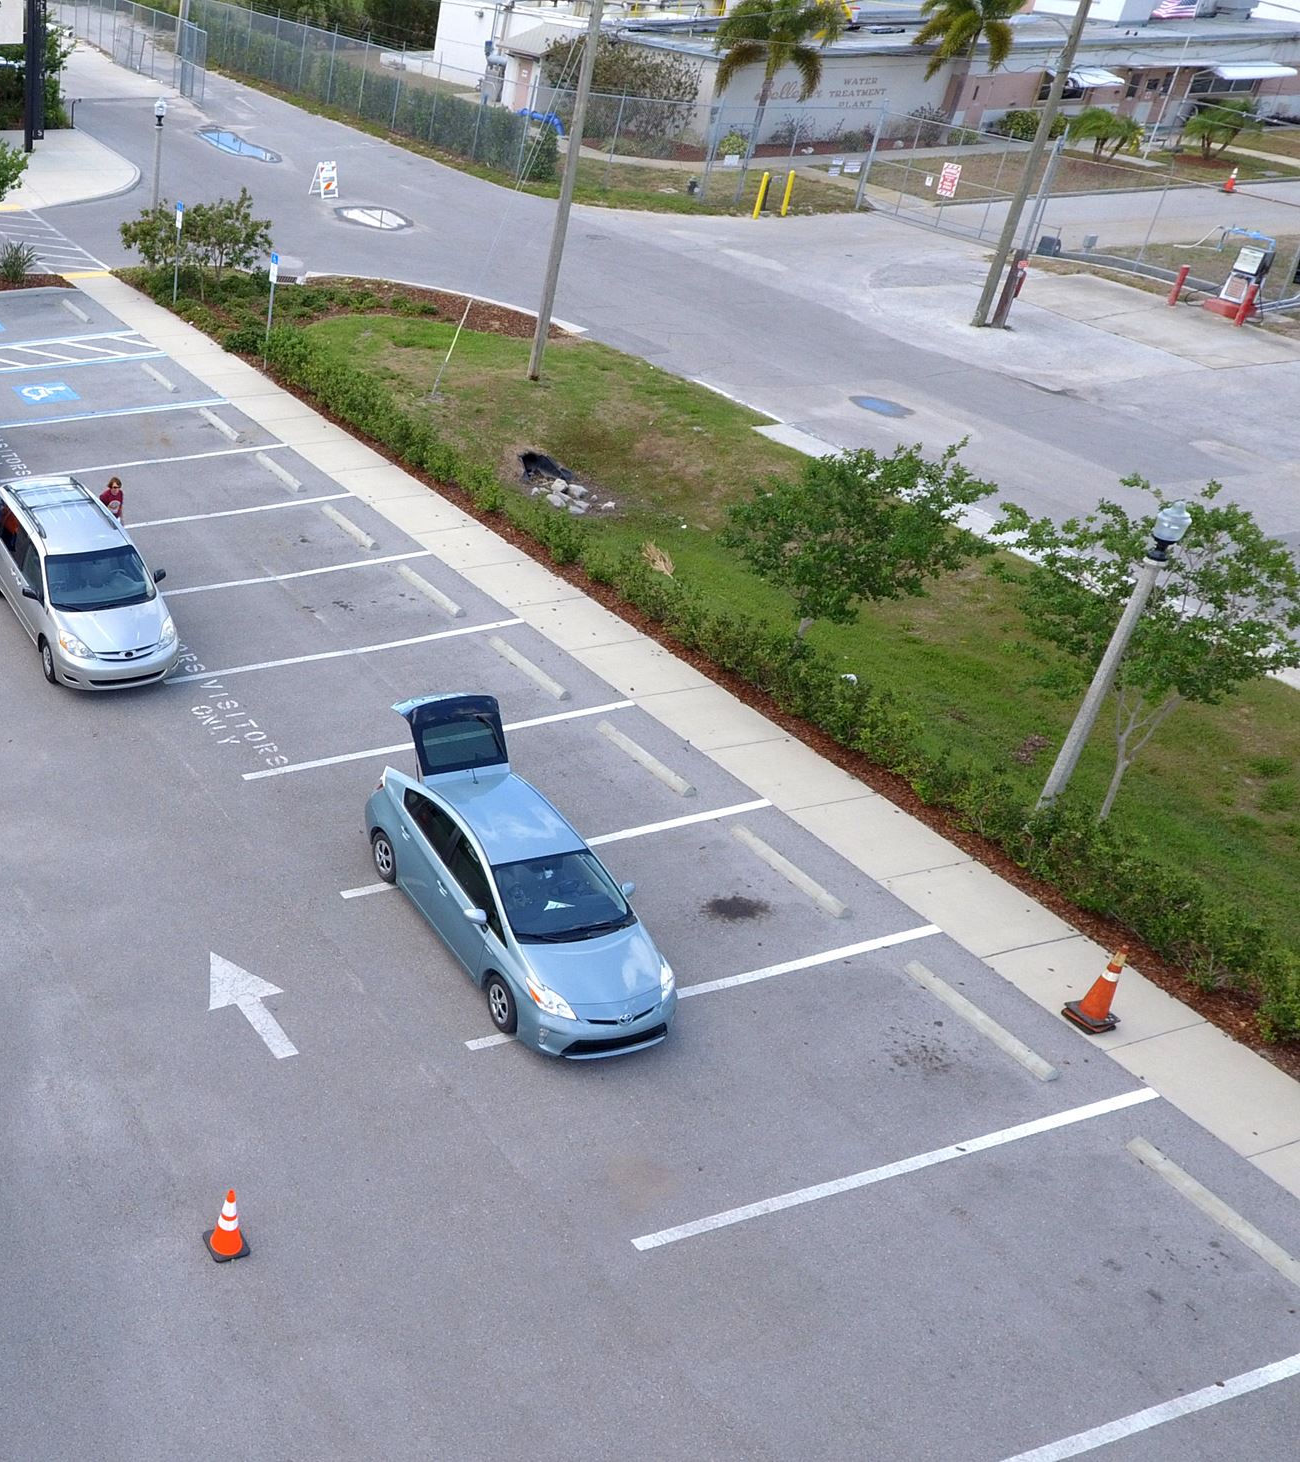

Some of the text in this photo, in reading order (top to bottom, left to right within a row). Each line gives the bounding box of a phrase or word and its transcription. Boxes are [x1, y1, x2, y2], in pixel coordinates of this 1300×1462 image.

[843, 77, 878, 86] WATER
[829, 88, 887, 98] TREATMENT
[838, 100, 872, 108] PLANT
[191, 705, 240, 744] ONLY
[200, 679, 288, 766] VISITORS
